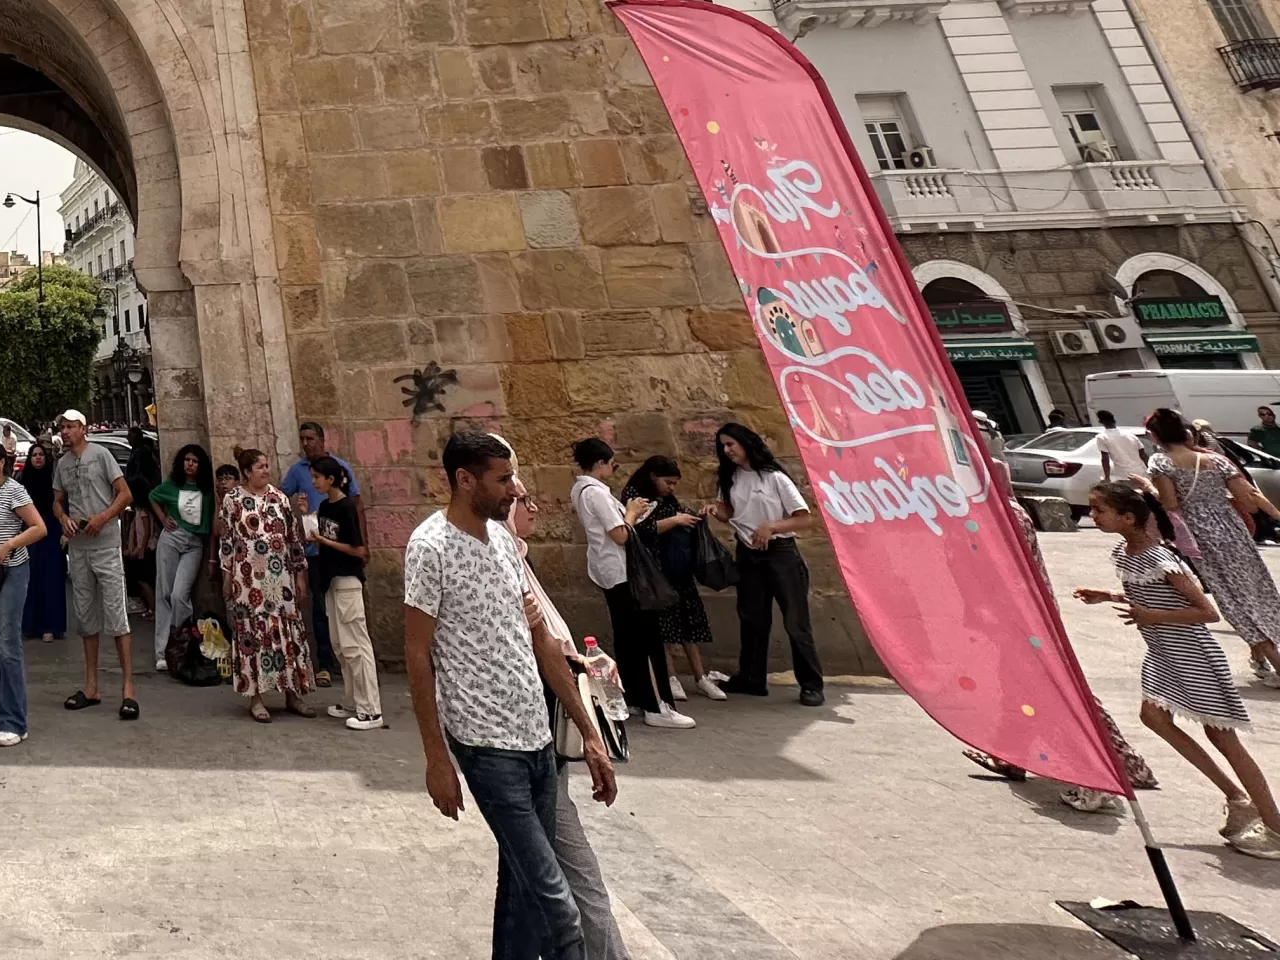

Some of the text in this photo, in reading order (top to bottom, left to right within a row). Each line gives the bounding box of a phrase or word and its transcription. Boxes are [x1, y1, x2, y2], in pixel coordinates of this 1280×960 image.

[932, 309, 1006, 327] صيدلية
[1139, 302, 1224, 319] PHARMACIE
[1202, 341, 1252, 353] صيدلية
